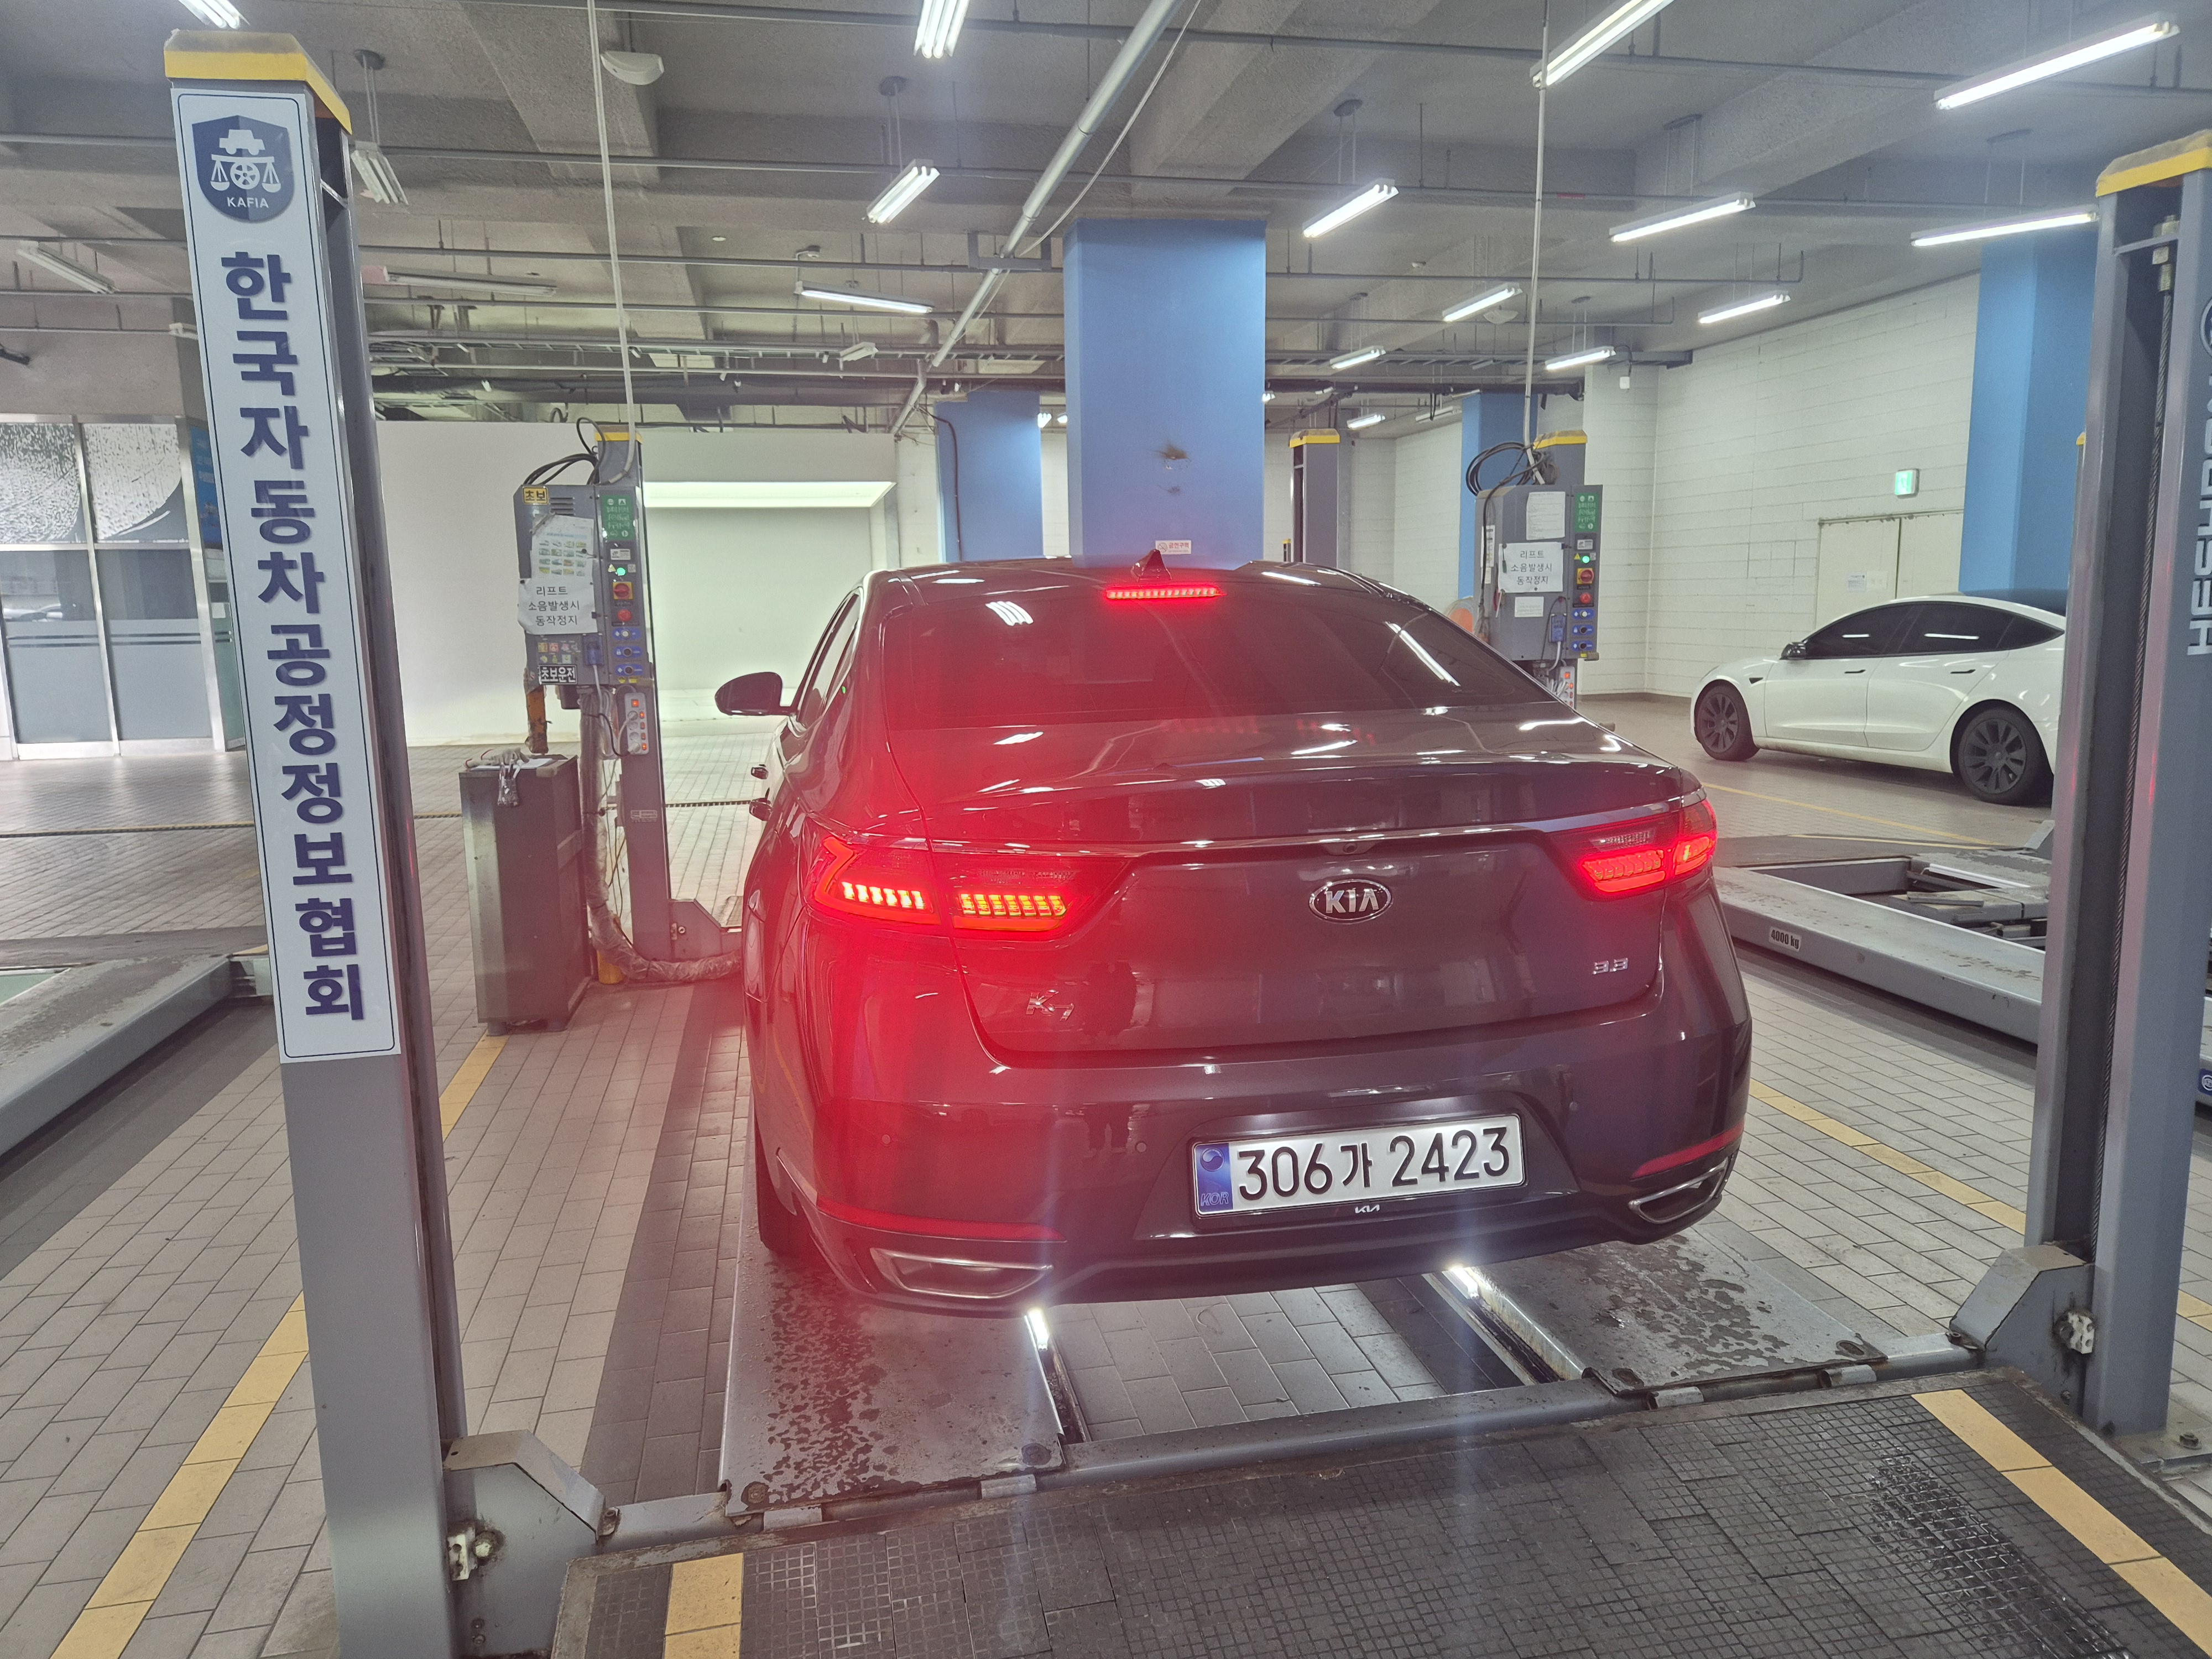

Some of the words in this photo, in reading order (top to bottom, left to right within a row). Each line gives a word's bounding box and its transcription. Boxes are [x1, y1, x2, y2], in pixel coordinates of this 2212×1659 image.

[227, 196, 269, 209] KAFIA
[525, 490, 546, 501] 초보
[1520, 550, 1545, 559] 리프트
[1510, 563, 1552, 572] 소음발생시
[1517, 576, 1548, 585] 동작정지
[536, 586, 568, 596] 리프트
[528, 600, 580, 611] 소음발생시
[535, 615, 578, 627] 동작정지
[221, 252, 364, 1020] 한국자동차공정정보협회
[541, 666, 576, 683] 초보운전
[1326, 888, 1379, 914] KIA
[1771, 929, 1789, 945] 4000
[1790, 935, 1799, 950] kg
[1593, 957, 1628, 975] 3.3
[1026, 989, 1074, 1021] K7
[1238, 1142, 1373, 1201] 306가
[1389, 1126, 1509, 1187] 2423
[1201, 1191, 1229, 1207] KOR
